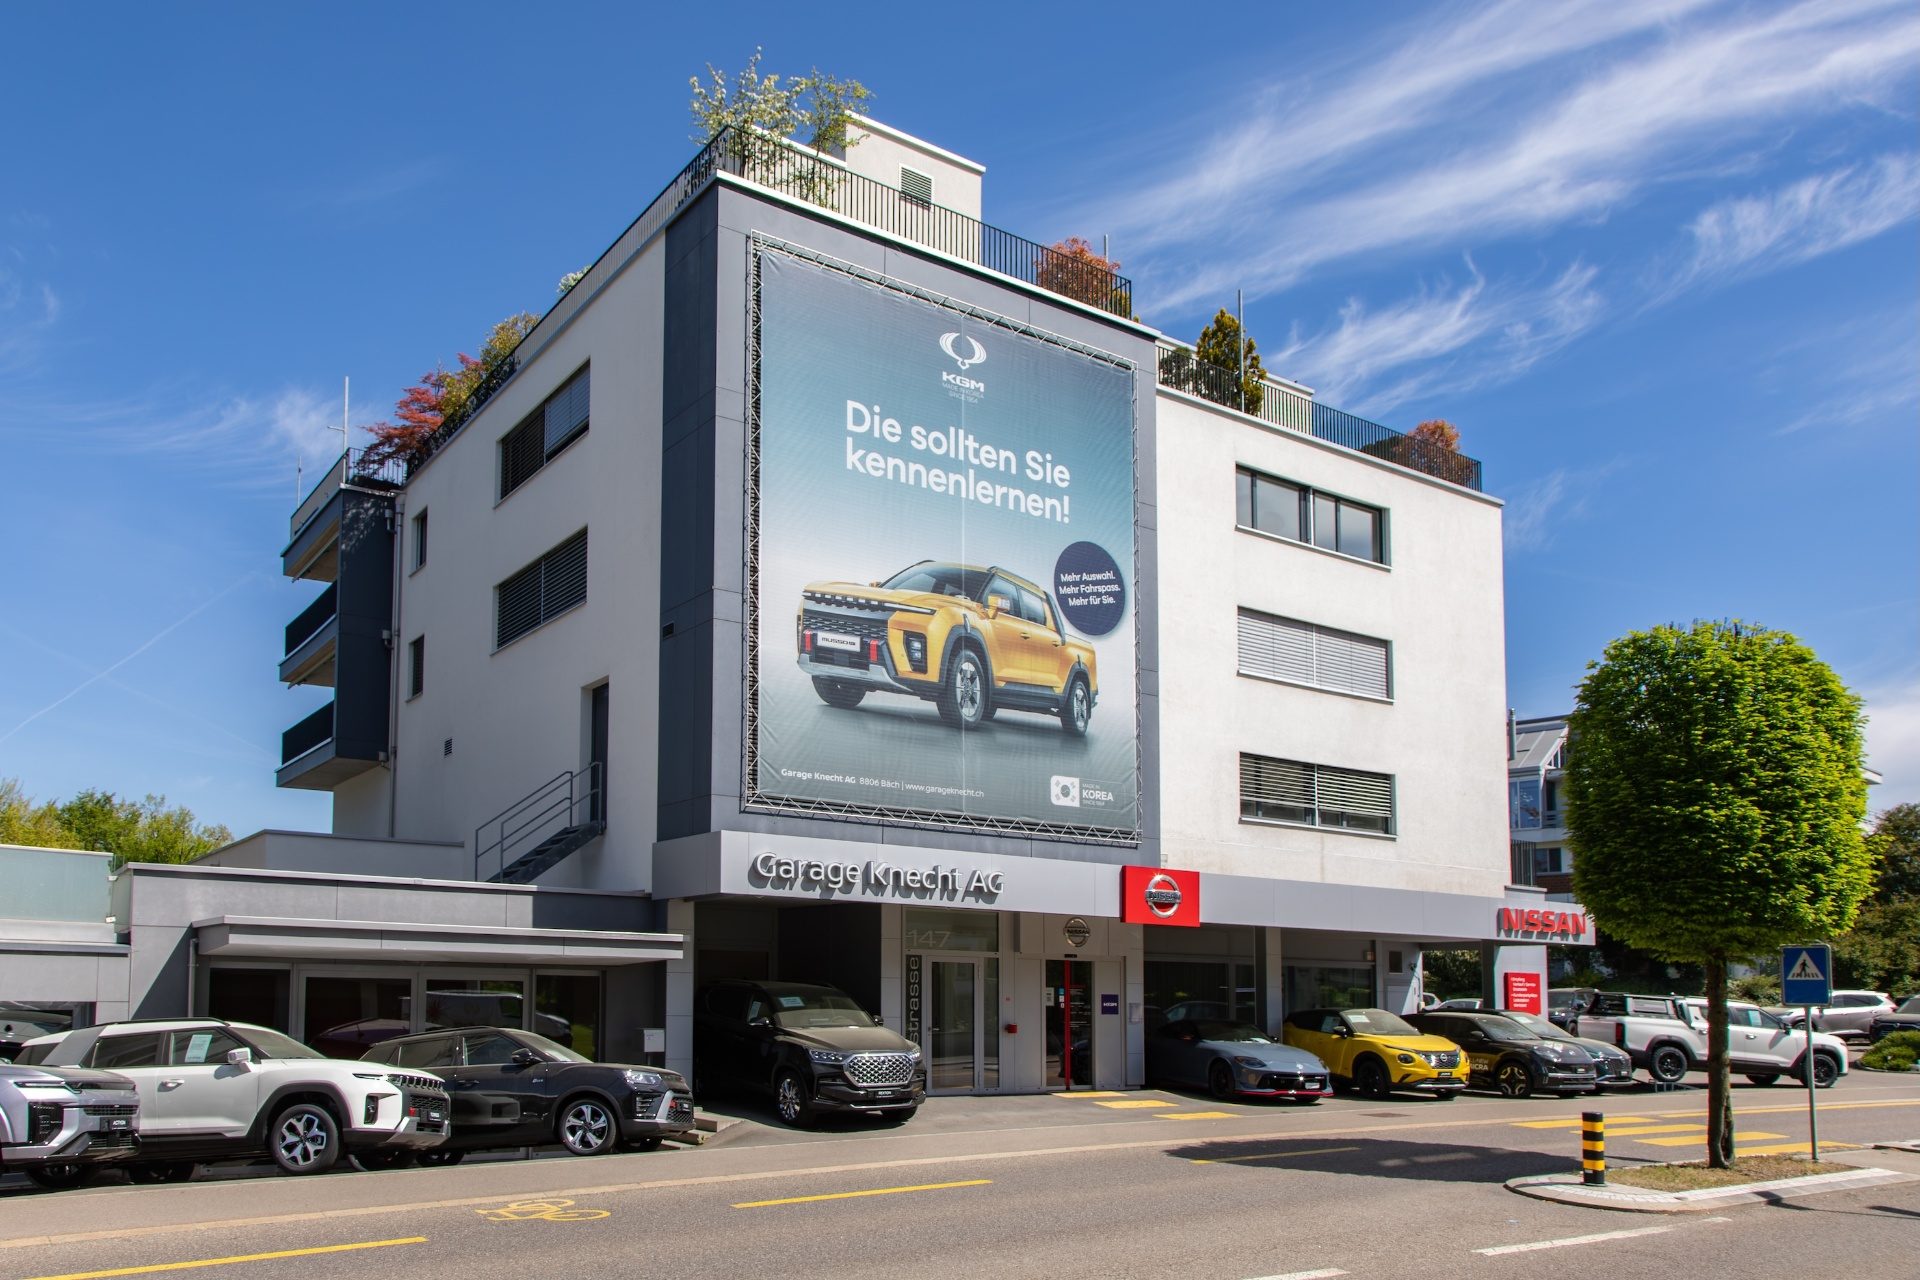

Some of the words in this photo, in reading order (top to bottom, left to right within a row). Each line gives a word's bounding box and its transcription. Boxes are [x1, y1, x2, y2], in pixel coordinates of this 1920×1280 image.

[942, 371, 985, 392] KGM
[846, 400, 902, 443] Die
[910, 426, 1016, 475] sollten
[1025, 450, 1070, 488] Sie
[846, 436, 1070, 524] kennenlernen!
[1060, 572, 1081, 582] Mehr
[1082, 570, 1116, 581] Auswahl.
[1059, 585, 1079, 595] Mehr
[1080, 584, 1121, 594] Fahrspass.
[1068, 597, 1088, 606] Mehr
[1089, 595, 1100, 605] für
[1101, 594, 1116, 604] Sie.
[781, 768, 813, 780] Garage
[814, 772, 843, 783] Knecht
[845, 775, 856, 784] AG
[859, 777, 880, 786] 8806
[881, 778, 900, 789] Bäch
[904, 782, 985, 798] www.garageknecht.ch
[1082, 789, 1114, 801] KOREA
[756, 852, 861, 888] Garage
[869, 860, 963, 890] Knecht
[969, 870, 1006, 894] AG
[1502, 907, 1586, 935] NISSAN
[905, 931, 950, 947] 147
